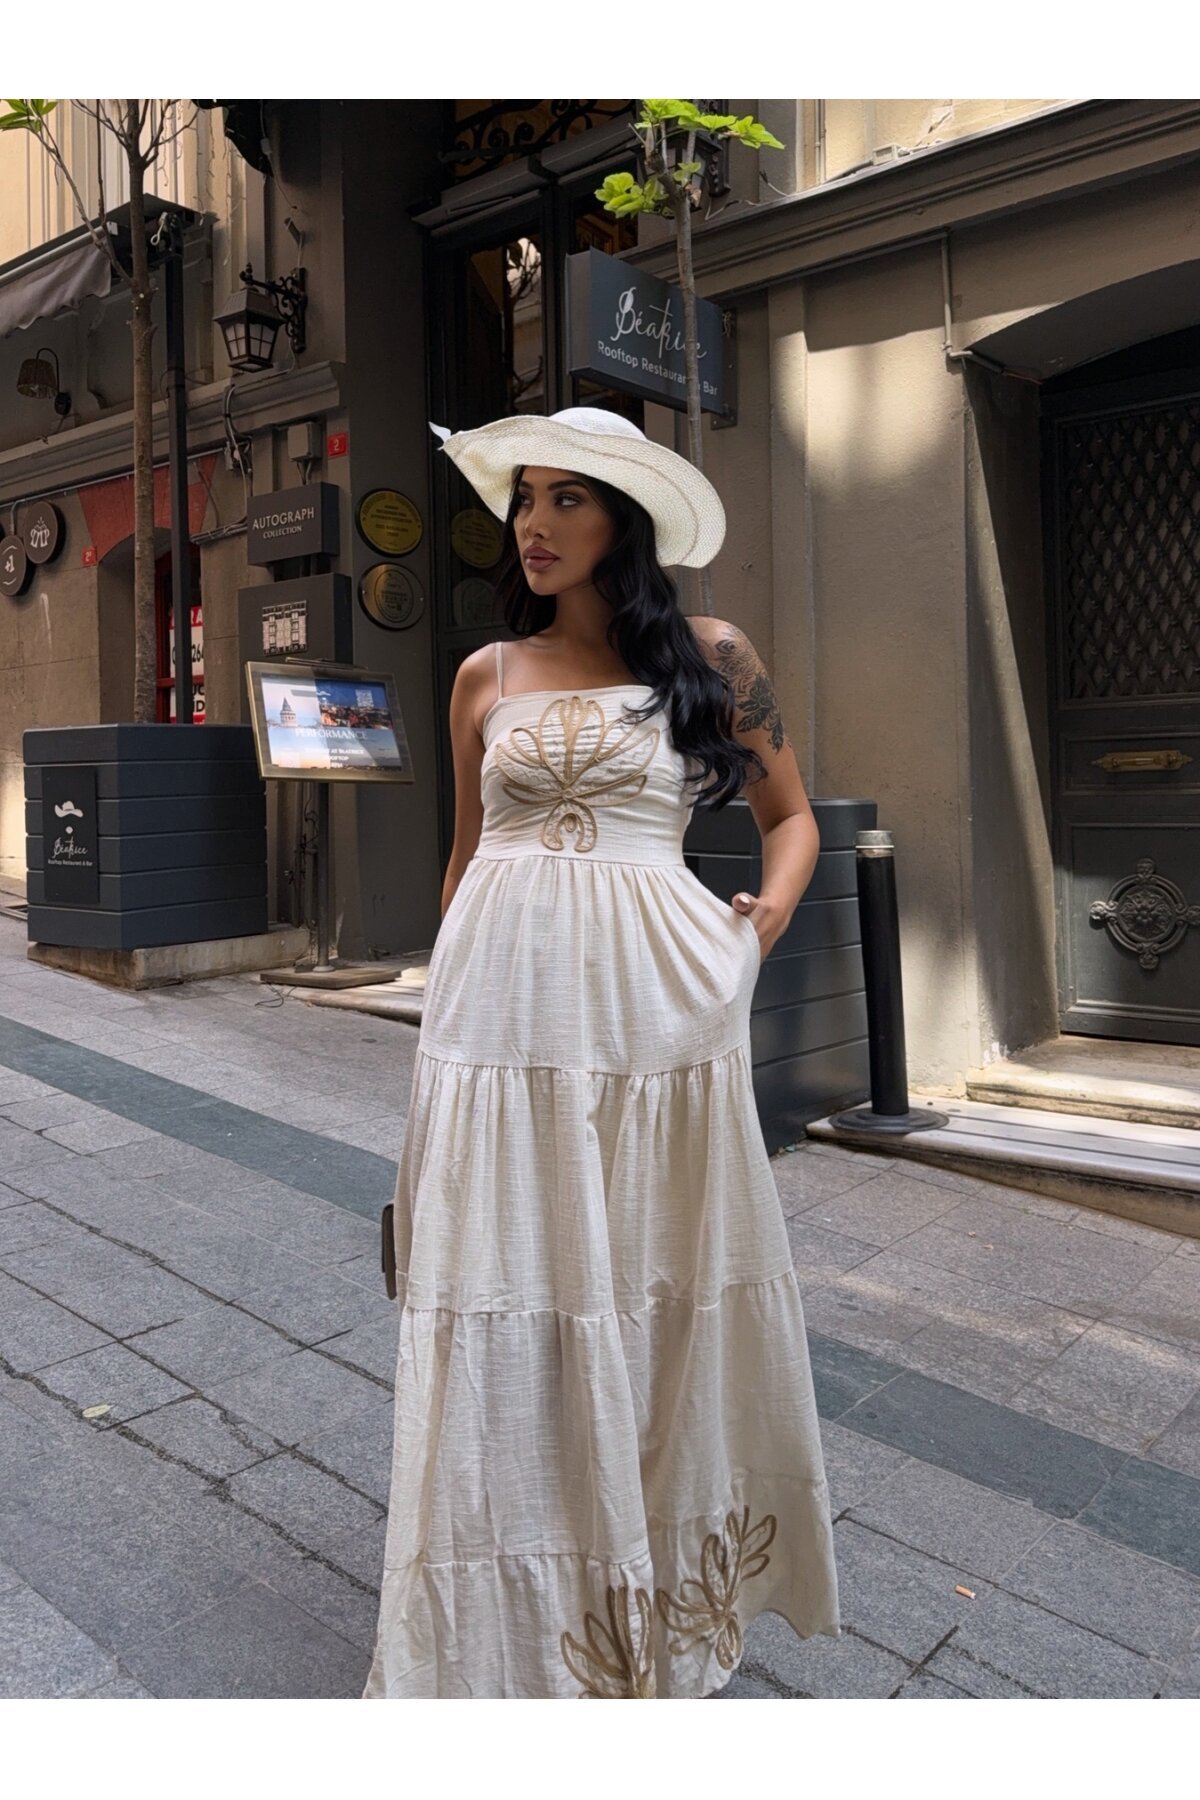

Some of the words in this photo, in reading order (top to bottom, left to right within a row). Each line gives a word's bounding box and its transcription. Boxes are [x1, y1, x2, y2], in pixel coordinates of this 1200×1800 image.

[597, 340, 639, 368] Rooftop
[703, 380, 718, 396] Bar
[333, 438, 340, 451] 2
[252, 506, 315, 531] AUTOGRAPH
[263, 525, 303, 539] COLLECTION
[295, 728, 368, 740] PERFORMANCE
